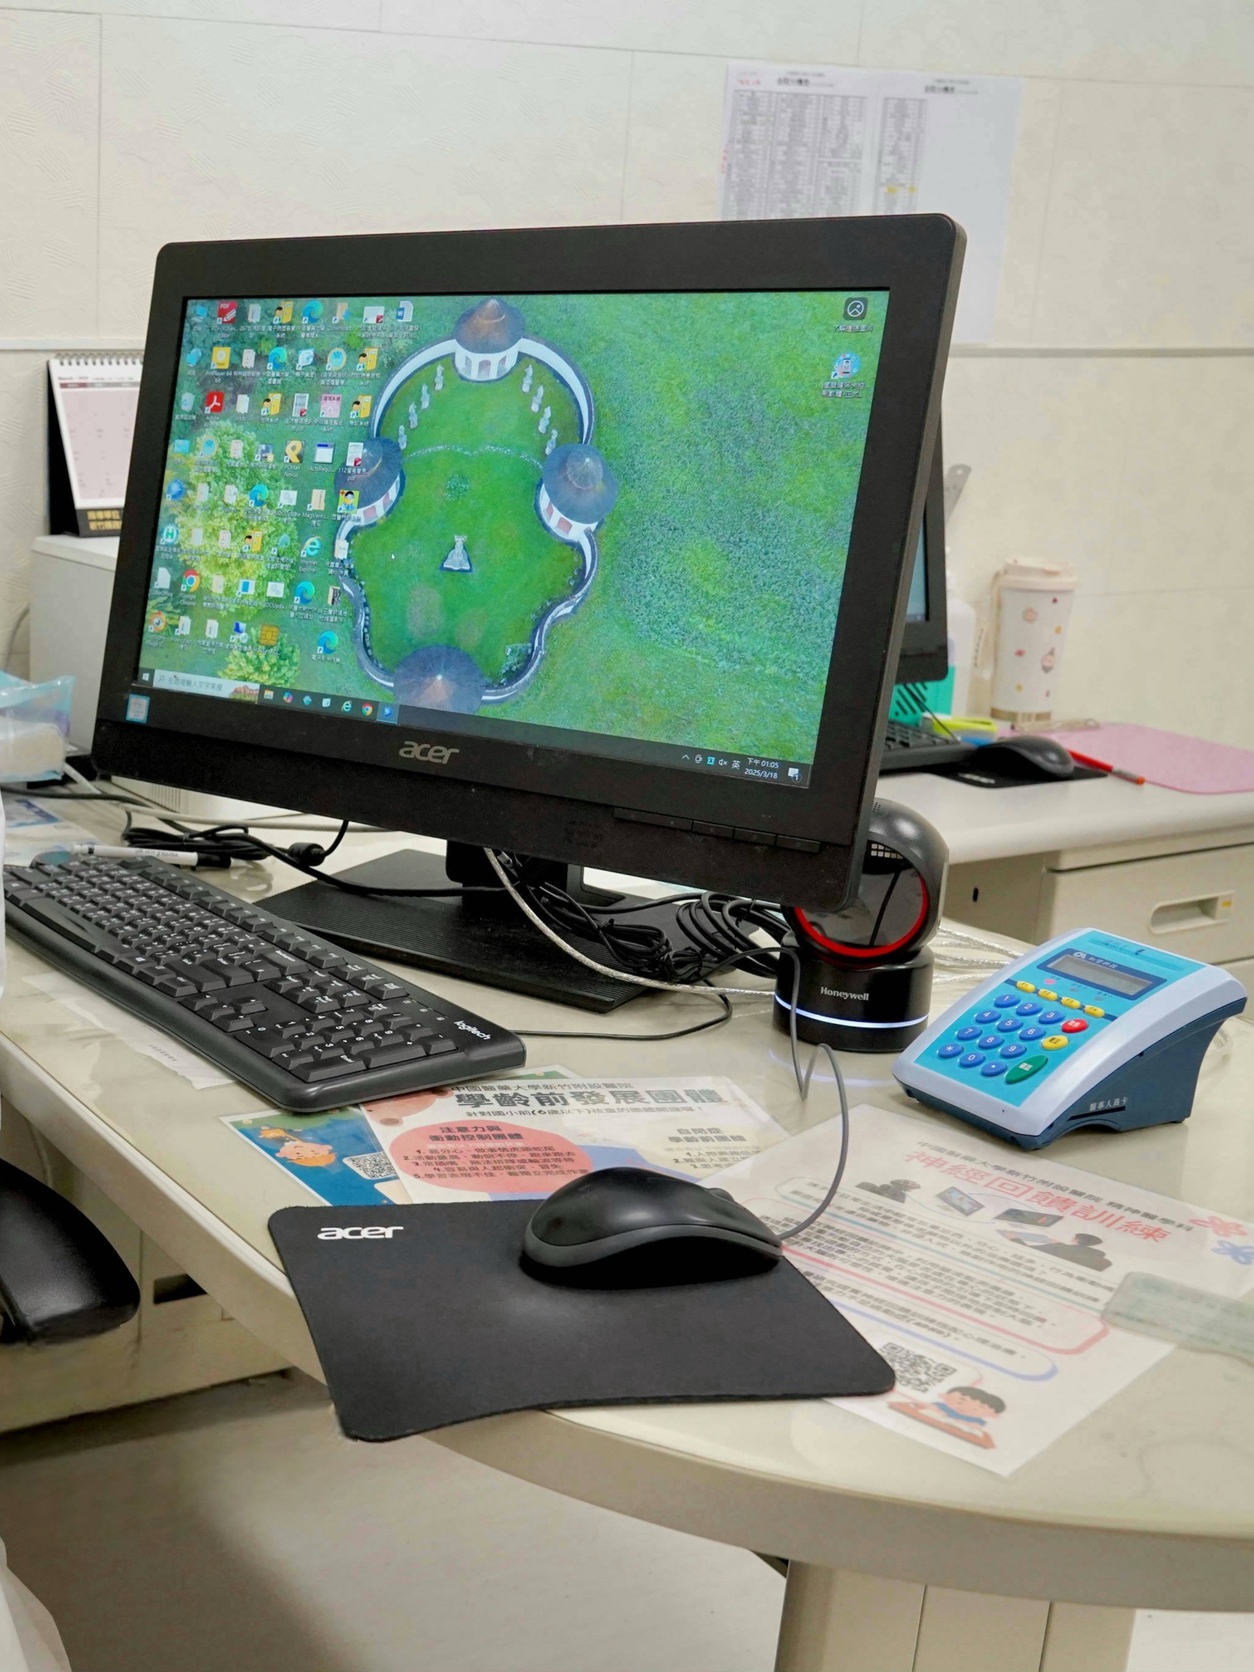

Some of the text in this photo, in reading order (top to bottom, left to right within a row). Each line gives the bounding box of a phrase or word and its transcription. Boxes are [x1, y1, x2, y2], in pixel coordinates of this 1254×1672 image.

[399, 741, 460, 765] acer
[731, 760, 741, 769] 英
[761, 760, 779, 769] 01:05
[744, 768, 778, 779] 2025/3/18
[820, 986, 870, 1002] Honeywell
[453, 1020, 491, 1041] logitech
[455, 1088, 728, 1109] 學齡前發展團體
[428, 1133, 524, 1142] 衝動控制團體
[439, 1125, 502, 1134] 注意力與
[905, 1151, 1172, 1243] 神經回饋訓練
[1106, 1200, 1194, 1232] 精神醫學科
[317, 1225, 403, 1241] acer
